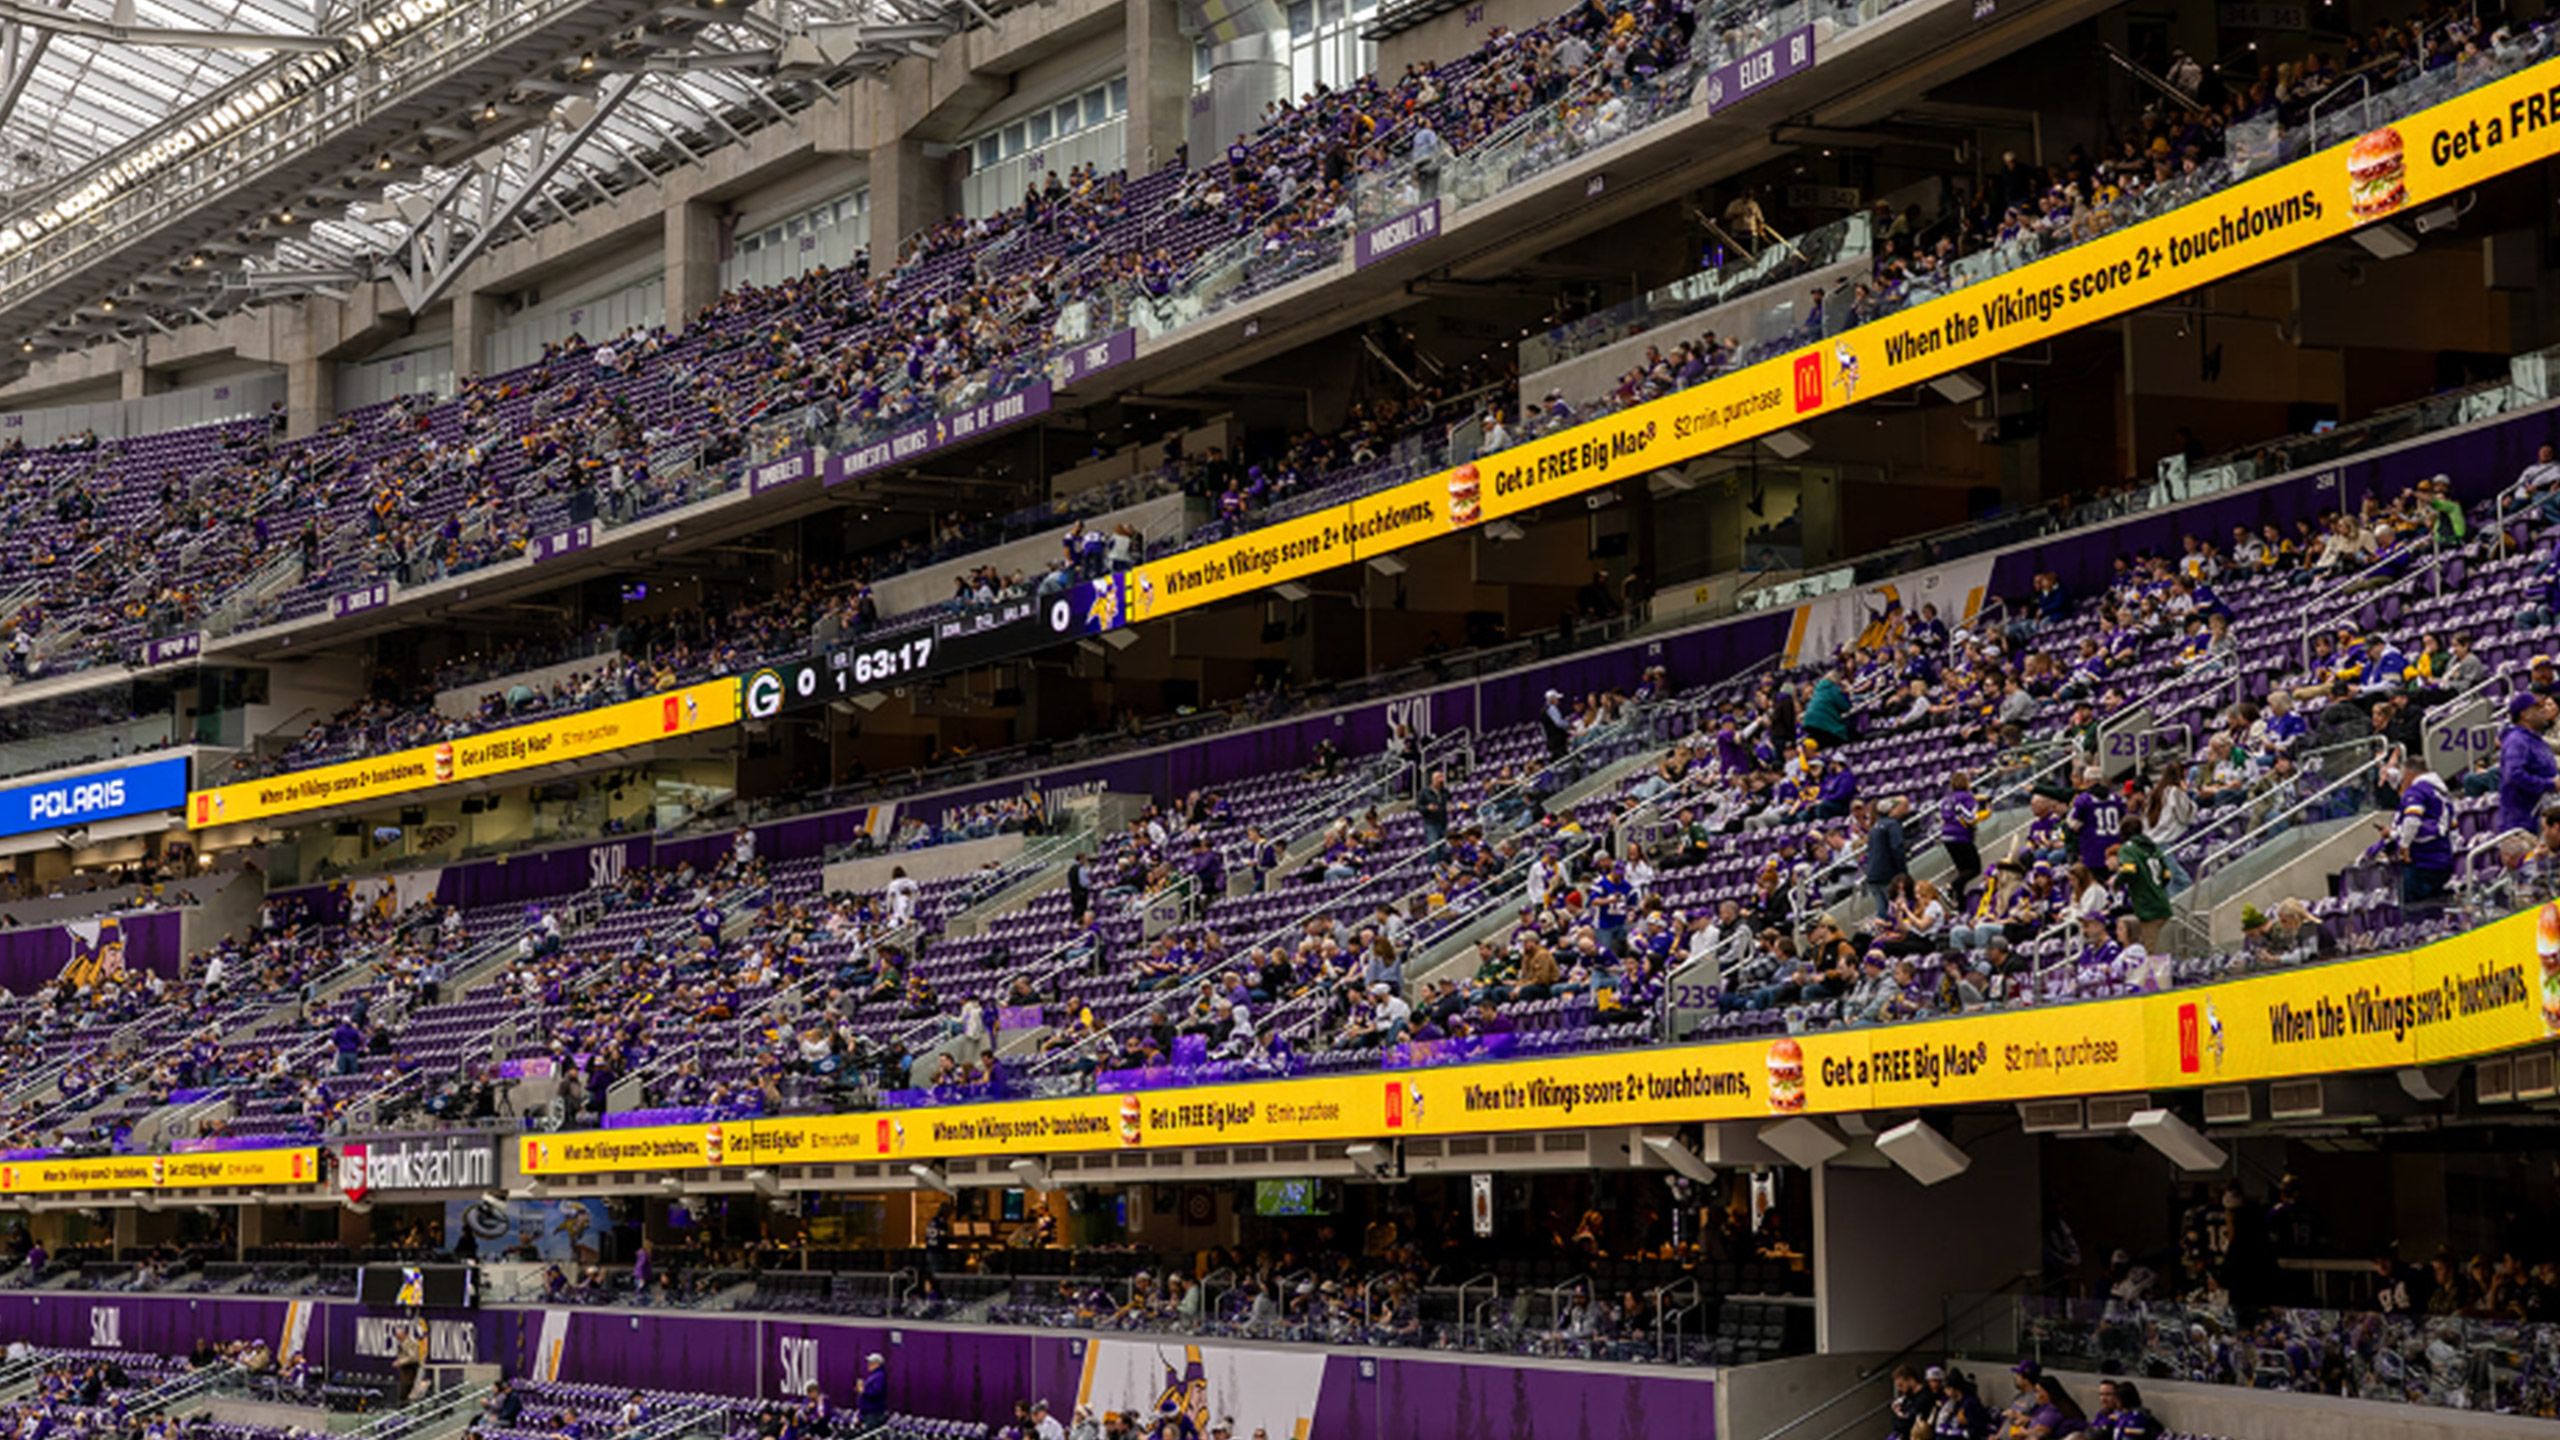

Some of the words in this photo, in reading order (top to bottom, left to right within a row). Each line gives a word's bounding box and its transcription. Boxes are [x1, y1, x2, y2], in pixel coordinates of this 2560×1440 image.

[1739, 51, 1775, 91] ELLER
[2432, 120, 2481, 166] Get
[2487, 118, 2502, 147] a
[1885, 328, 1941, 366] When
[1945, 313, 1979, 345] the
[1983, 284, 2064, 331] Vikings
[2069, 260, 2132, 303] score
[2136, 247, 2163, 279] 2+
[2169, 190, 2322, 267] touchdowns,
[1674, 415, 1692, 440] $2
[1693, 408, 1722, 433] min.
[1723, 388, 1782, 429] purchase
[1496, 466, 1523, 497] Get
[1526, 467, 1534, 487] a
[1538, 447, 1578, 483] FREE
[1582, 438, 1608, 471] Big
[1166, 570, 1202, 595] When
[1204, 561, 1226, 584] the
[1228, 547, 1279, 576] Vikings
[1281, 536, 1320, 562] score
[1323, 527, 1339, 550] 2+
[1342, 501, 1435, 544] touchdowns,
[1050, 599, 1070, 631] 0
[854, 637, 932, 683] 63:17
[797, 667, 816, 696] 0
[836, 671, 846, 692] 1
[30, 779, 125, 821] POLARIS
[2093, 807, 2120, 836] 10
[1676, 984, 1720, 1009] 239
[2269, 1003, 2315, 1044] When
[2317, 996, 2345, 1038] the
[2347, 986, 2414, 1043] Vikings
[1822, 1057, 1854, 1087] Get
[1858, 1061, 1868, 1084] a
[1872, 1050, 1911, 1082] FREE
[1914, 1044, 1939, 1087] Big
[2005, 1044, 2022, 1073] $2
[2024, 1041, 2052, 1069] min.
[2055, 1037, 2118, 1075] purchase
[1464, 1084, 1500, 1111] When
[1503, 1083, 1525, 1109] the
[1527, 1077, 1581, 1113] Vikings
[1583, 1081, 1624, 1104] score
[1627, 1074, 1644, 1101] 2+
[1647, 1068, 1750, 1100] touchdowns,
[933, 1122, 957, 1142] When
[957, 1121, 975, 1140] the
[976, 1117, 1013, 1144] Vikings
[1150, 1108, 1168, 1129] Get
[1179, 1104, 1204, 1127] FREE
[1207, 1103, 1224, 1132] Big
